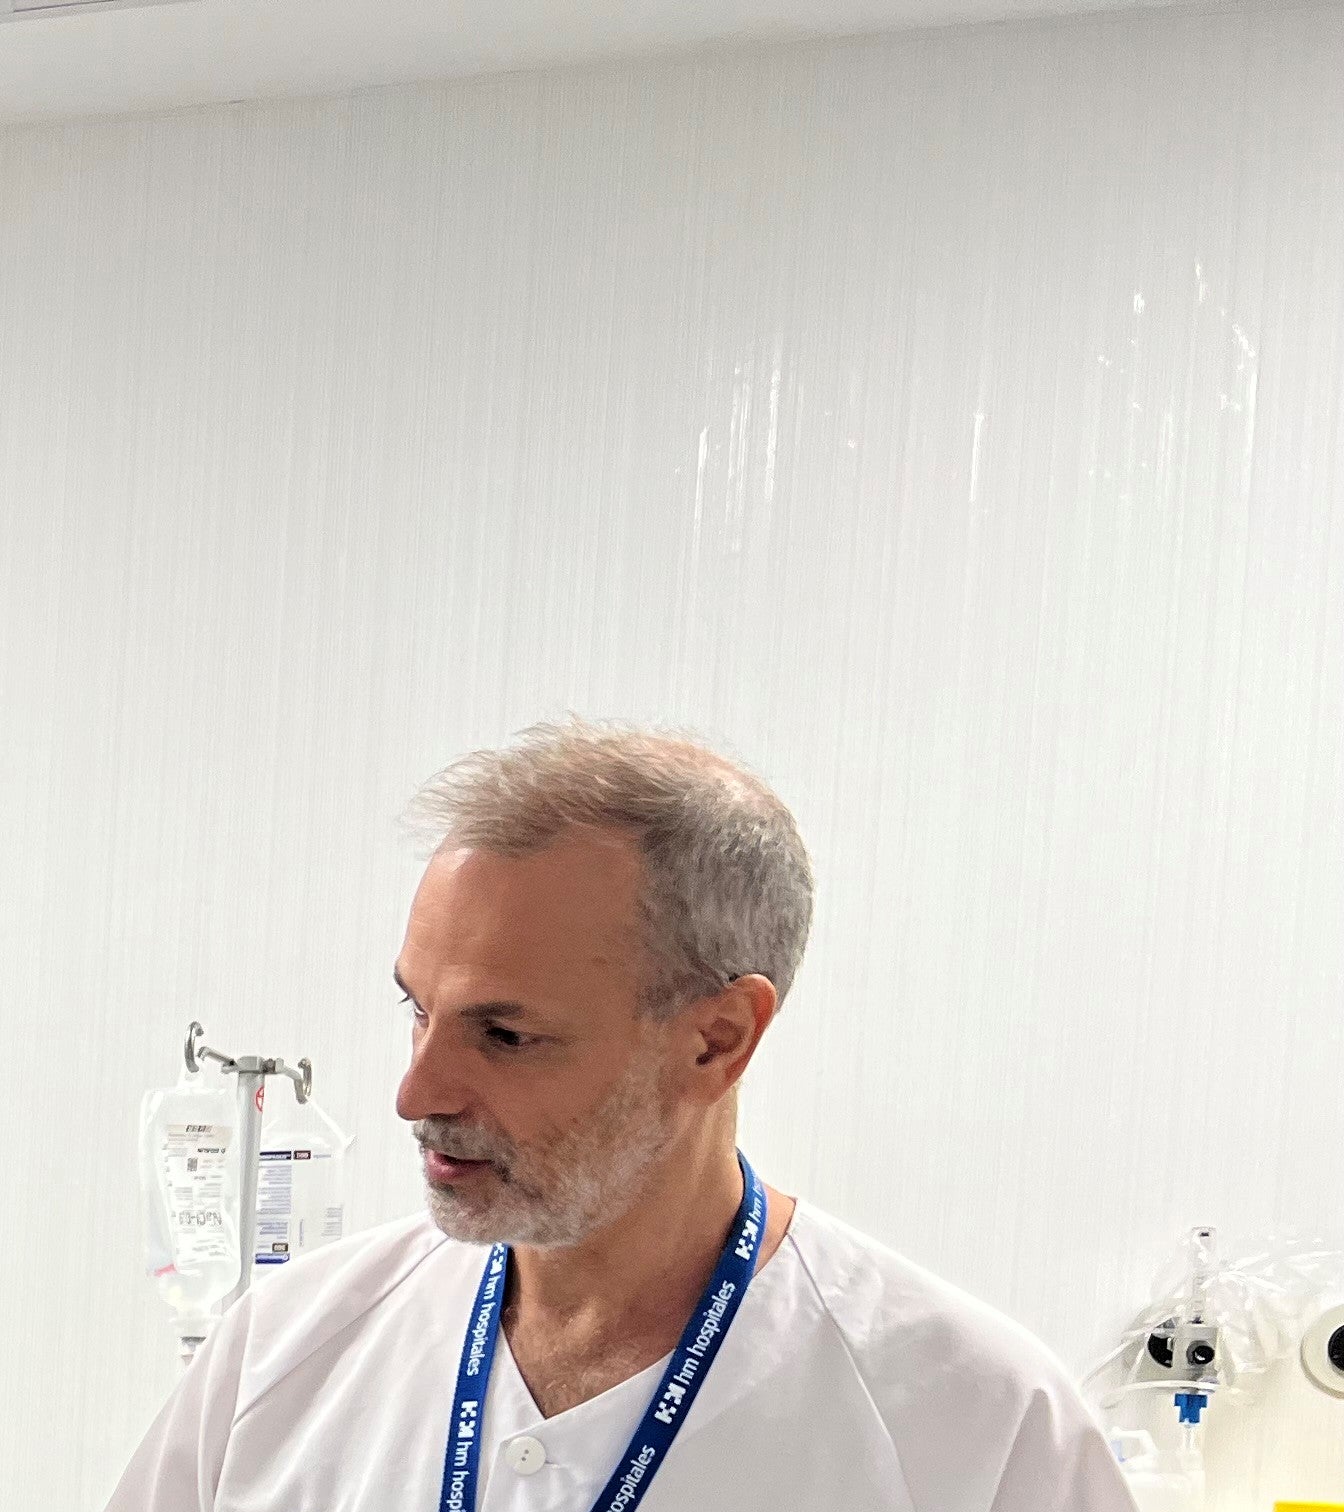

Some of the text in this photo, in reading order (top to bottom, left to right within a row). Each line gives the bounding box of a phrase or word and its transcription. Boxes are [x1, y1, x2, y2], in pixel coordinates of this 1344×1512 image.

[484, 1275, 501, 1300] hm
[686, 1280, 736, 1357] hospitales
[467, 1302, 496, 1376] hospitales
[673, 1357, 700, 1385] hm
[454, 1441, 473, 1467] hm
